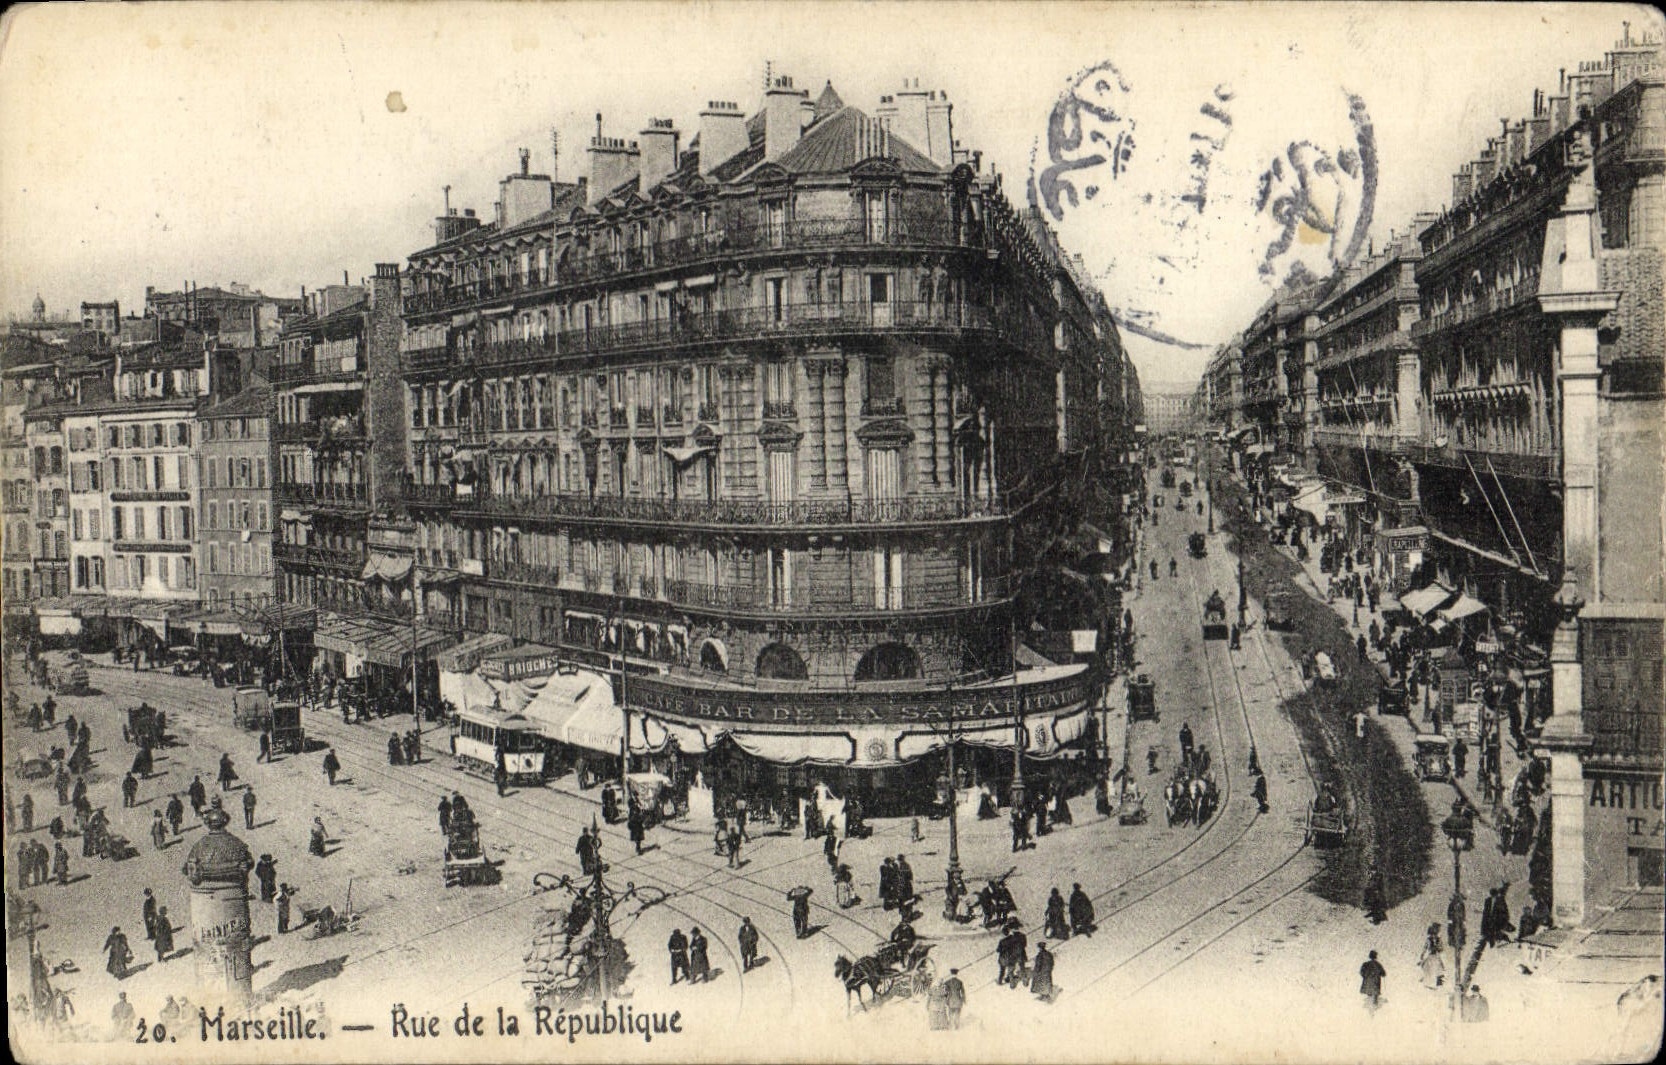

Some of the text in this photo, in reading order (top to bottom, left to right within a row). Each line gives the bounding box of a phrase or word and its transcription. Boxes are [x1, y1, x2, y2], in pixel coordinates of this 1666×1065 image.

[699, 703, 754, 719] BAR
[772, 707, 814, 720] DE
[836, 706, 883, 720] LA
